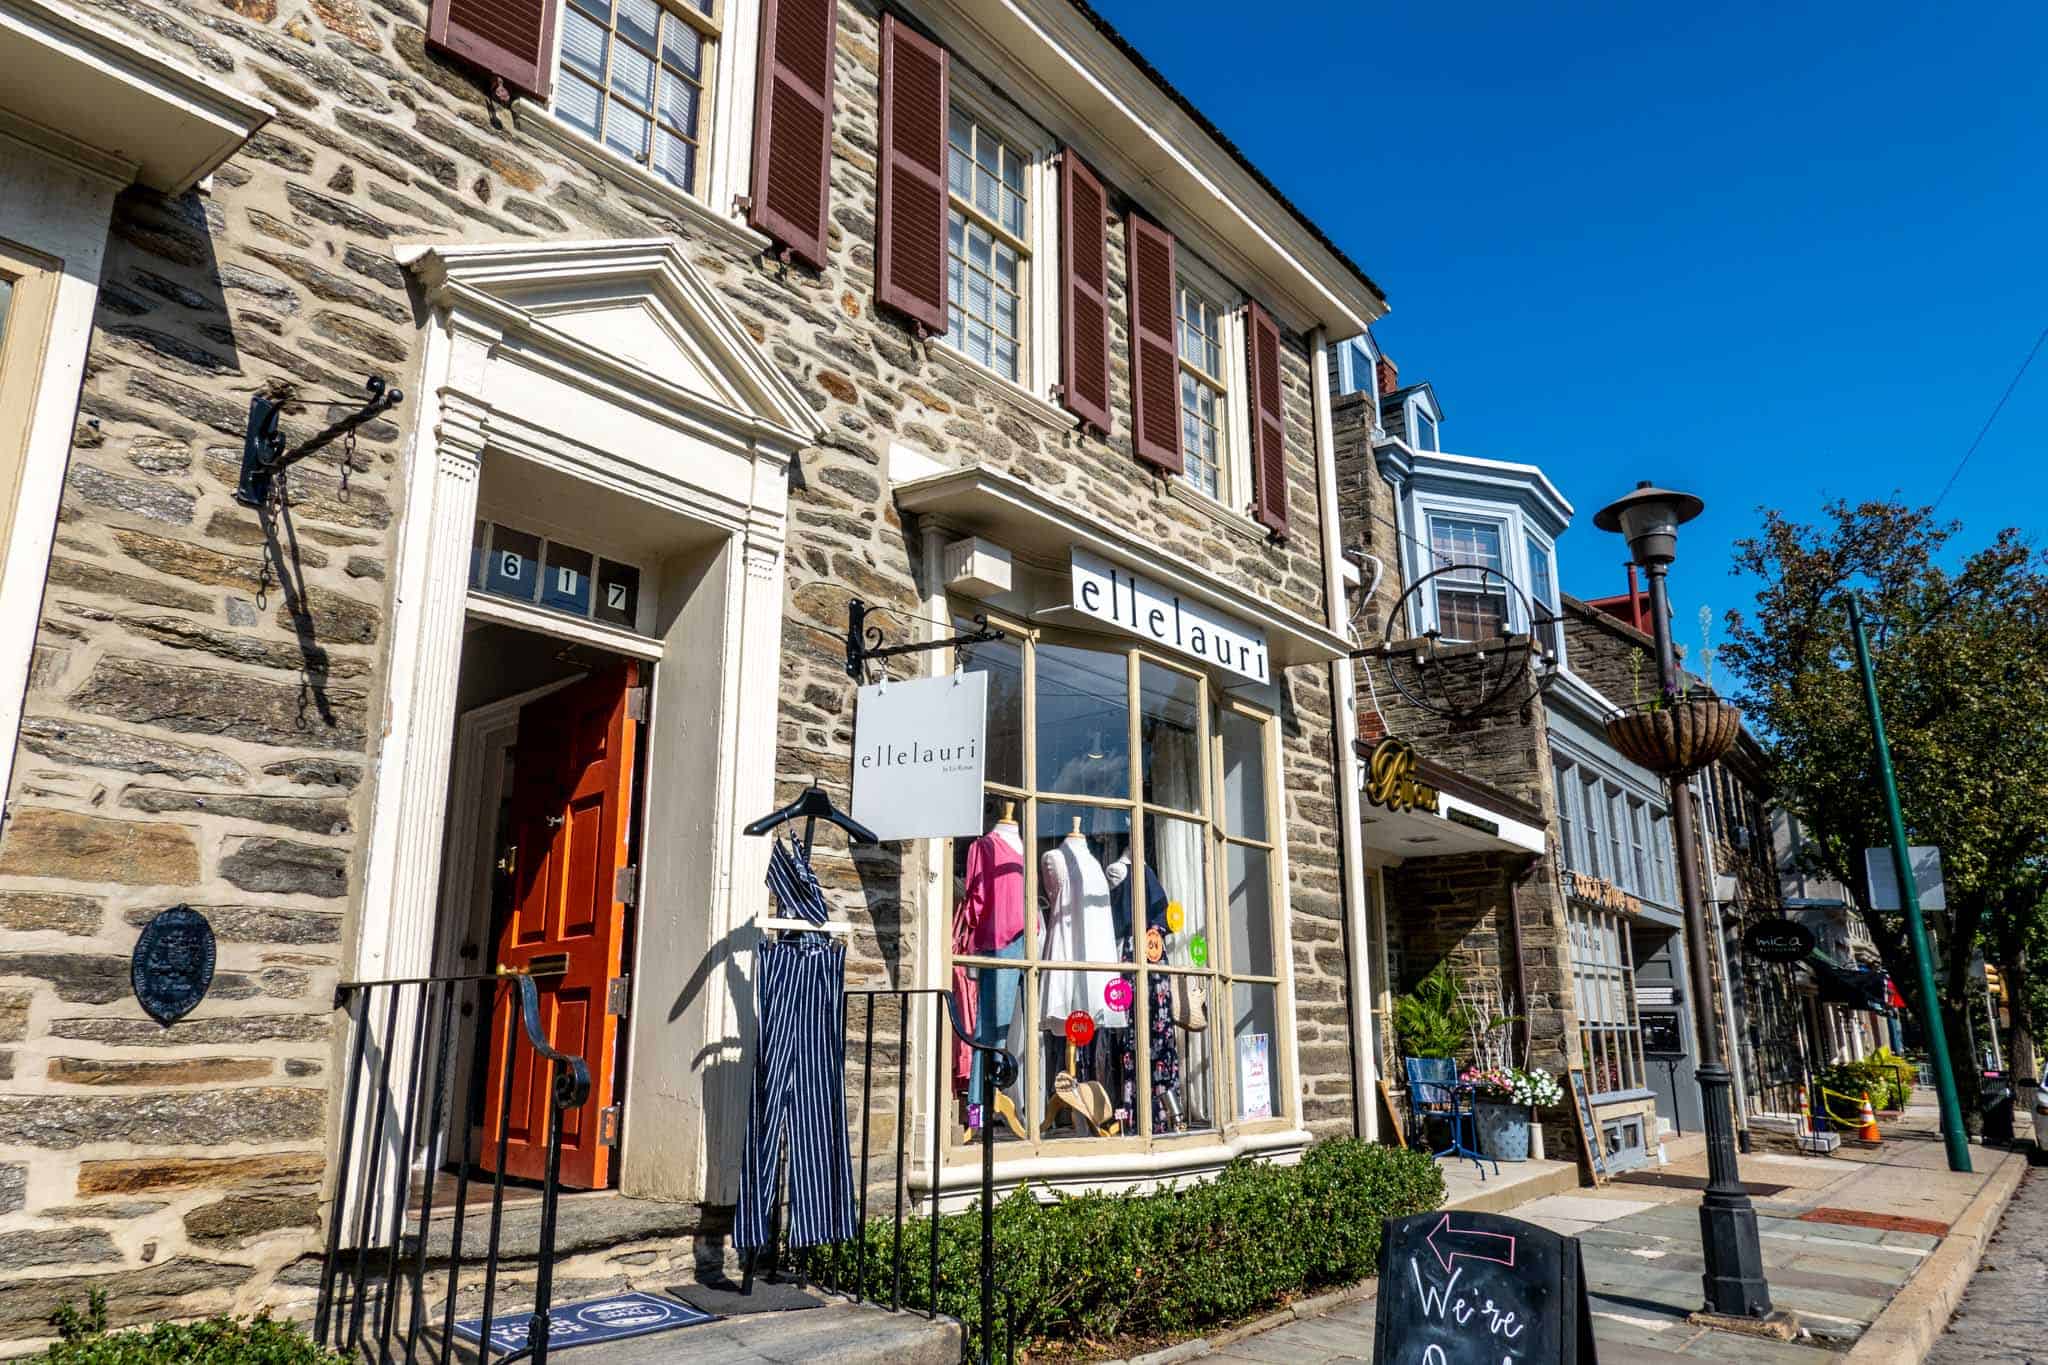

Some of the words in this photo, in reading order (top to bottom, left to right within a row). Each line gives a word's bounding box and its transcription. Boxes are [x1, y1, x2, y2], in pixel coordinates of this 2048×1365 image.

[1081, 568, 1265, 679] ellelauri
[861, 737, 976, 769] ellelauri
[1410, 1256, 1524, 1339] We're
